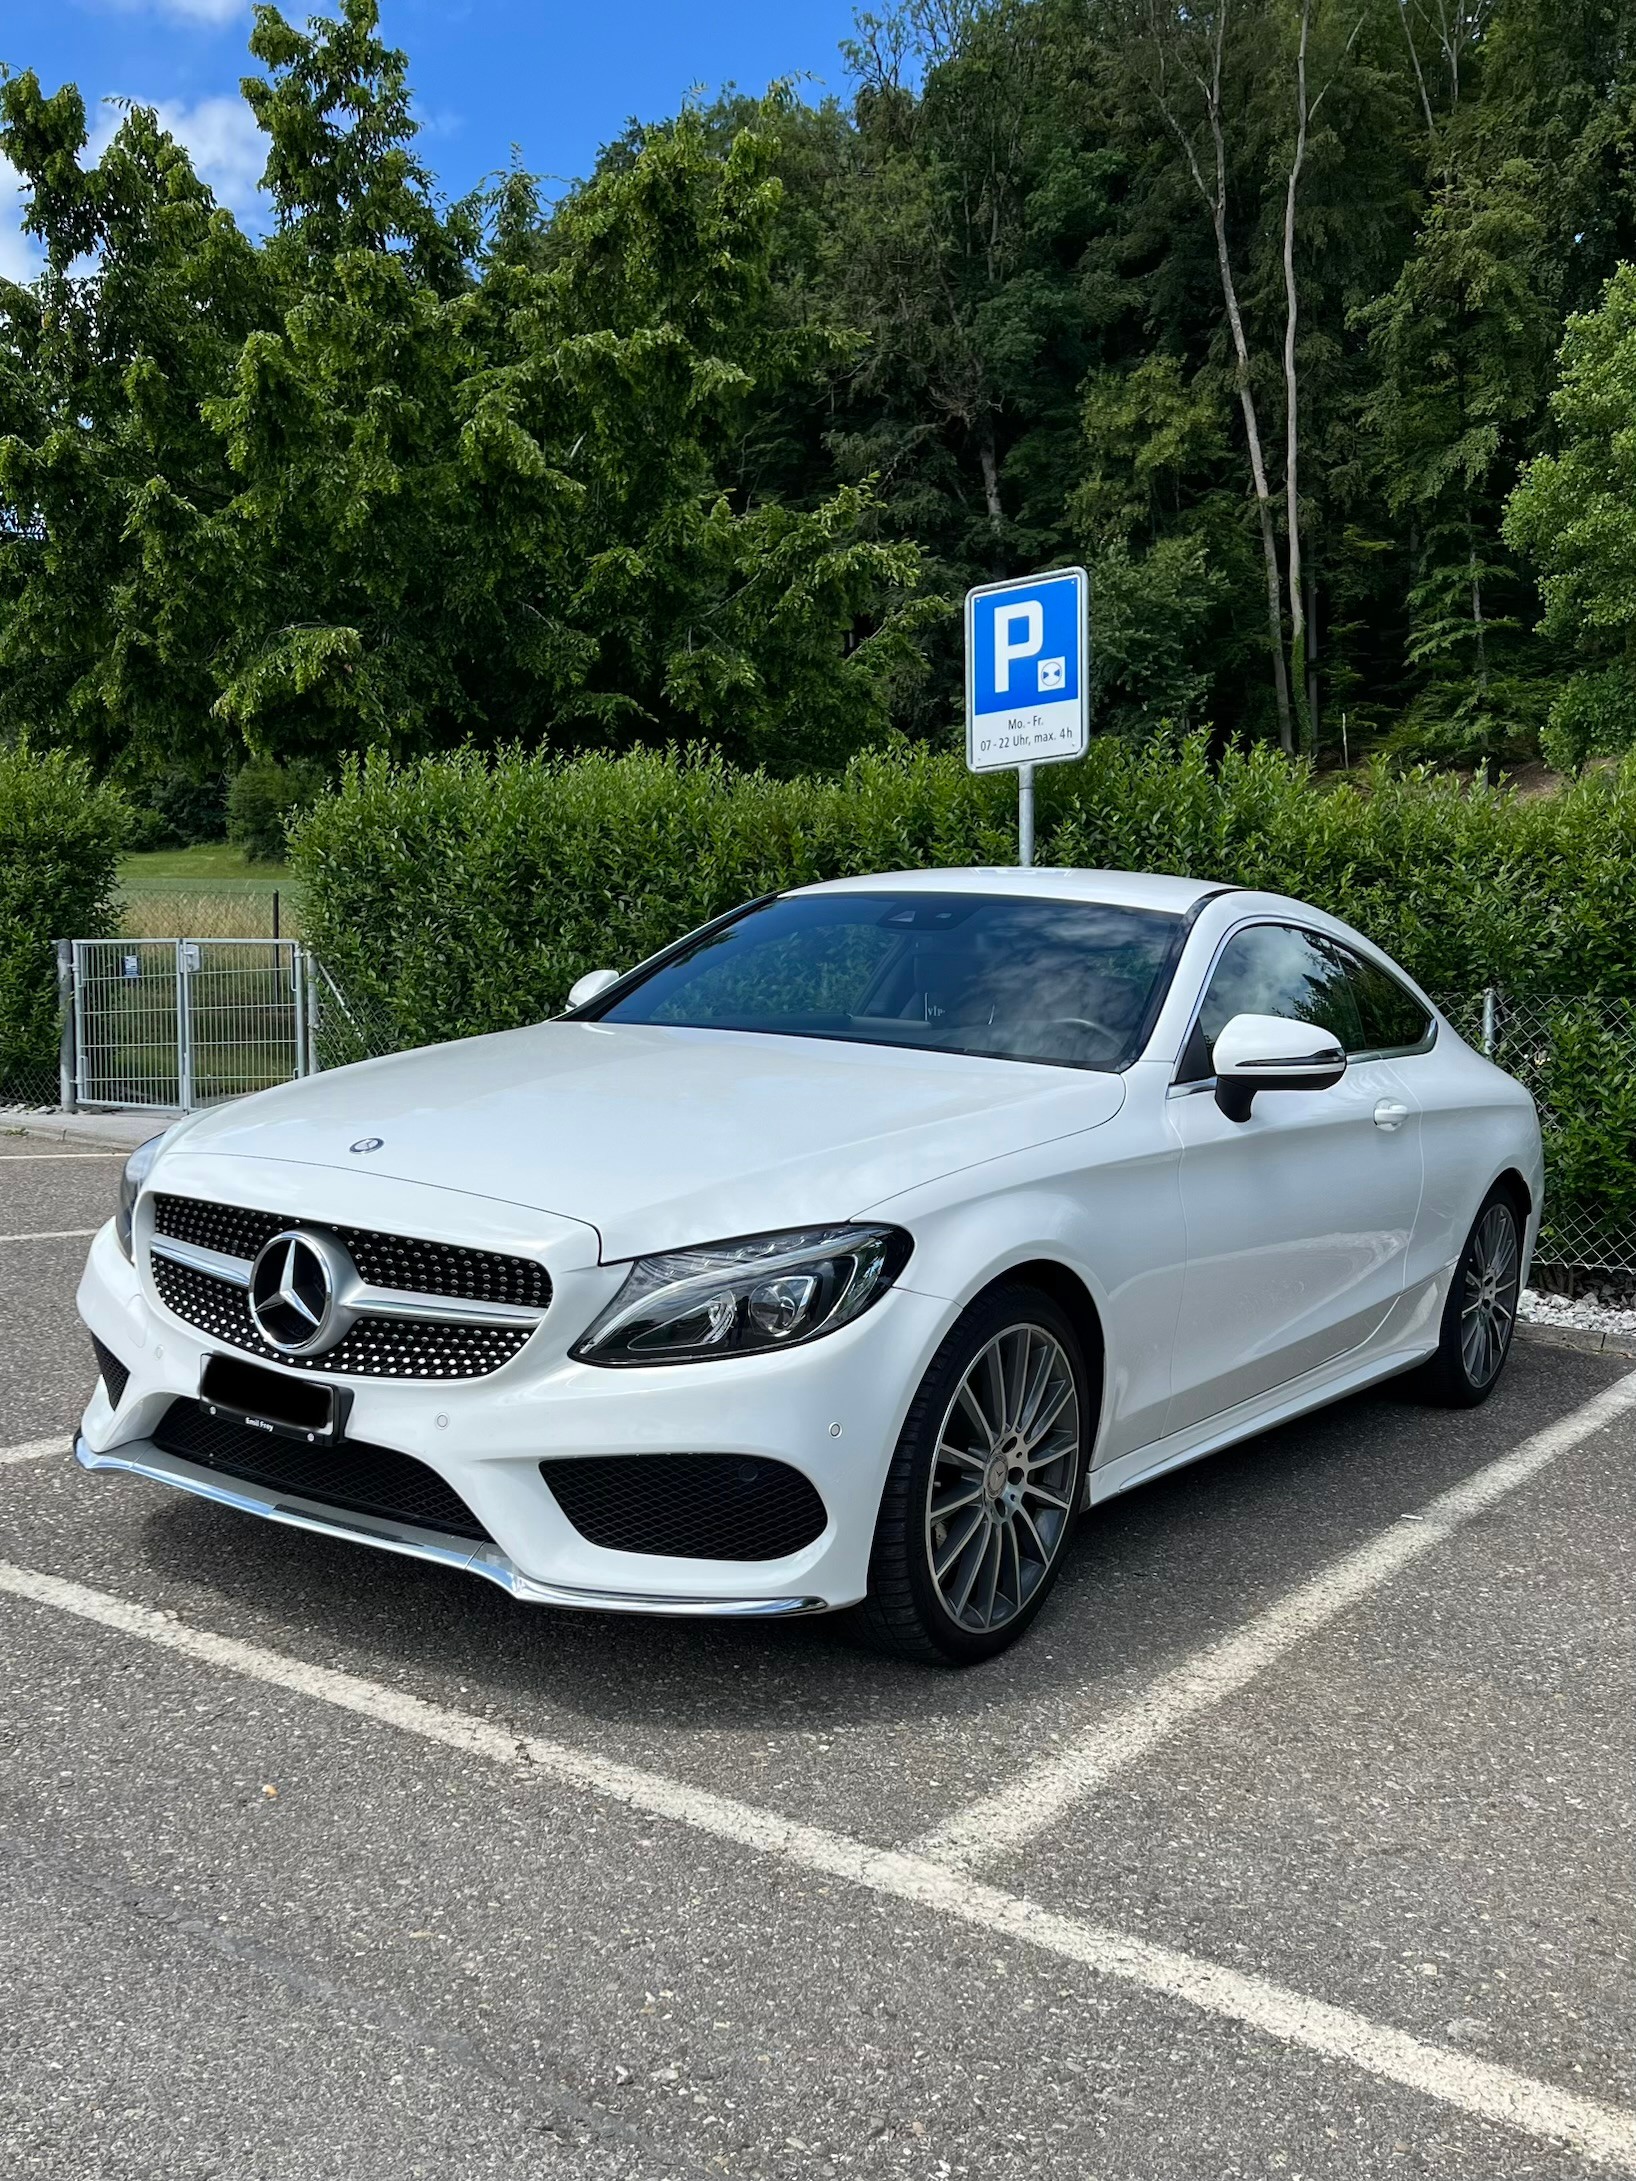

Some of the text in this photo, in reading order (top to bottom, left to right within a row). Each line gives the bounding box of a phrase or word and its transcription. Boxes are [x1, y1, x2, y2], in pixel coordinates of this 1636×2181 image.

[994, 600, 1044, 693] P
[1008, 718, 1025, 730] Mo.
[1033, 715, 1044, 726] Fr.
[999, 737, 1010, 749] 22
[1013, 734, 1031, 746] Uhr,
[1034, 732, 1056, 743] max.
[245, 1417, 274, 1432] Emil Frey
